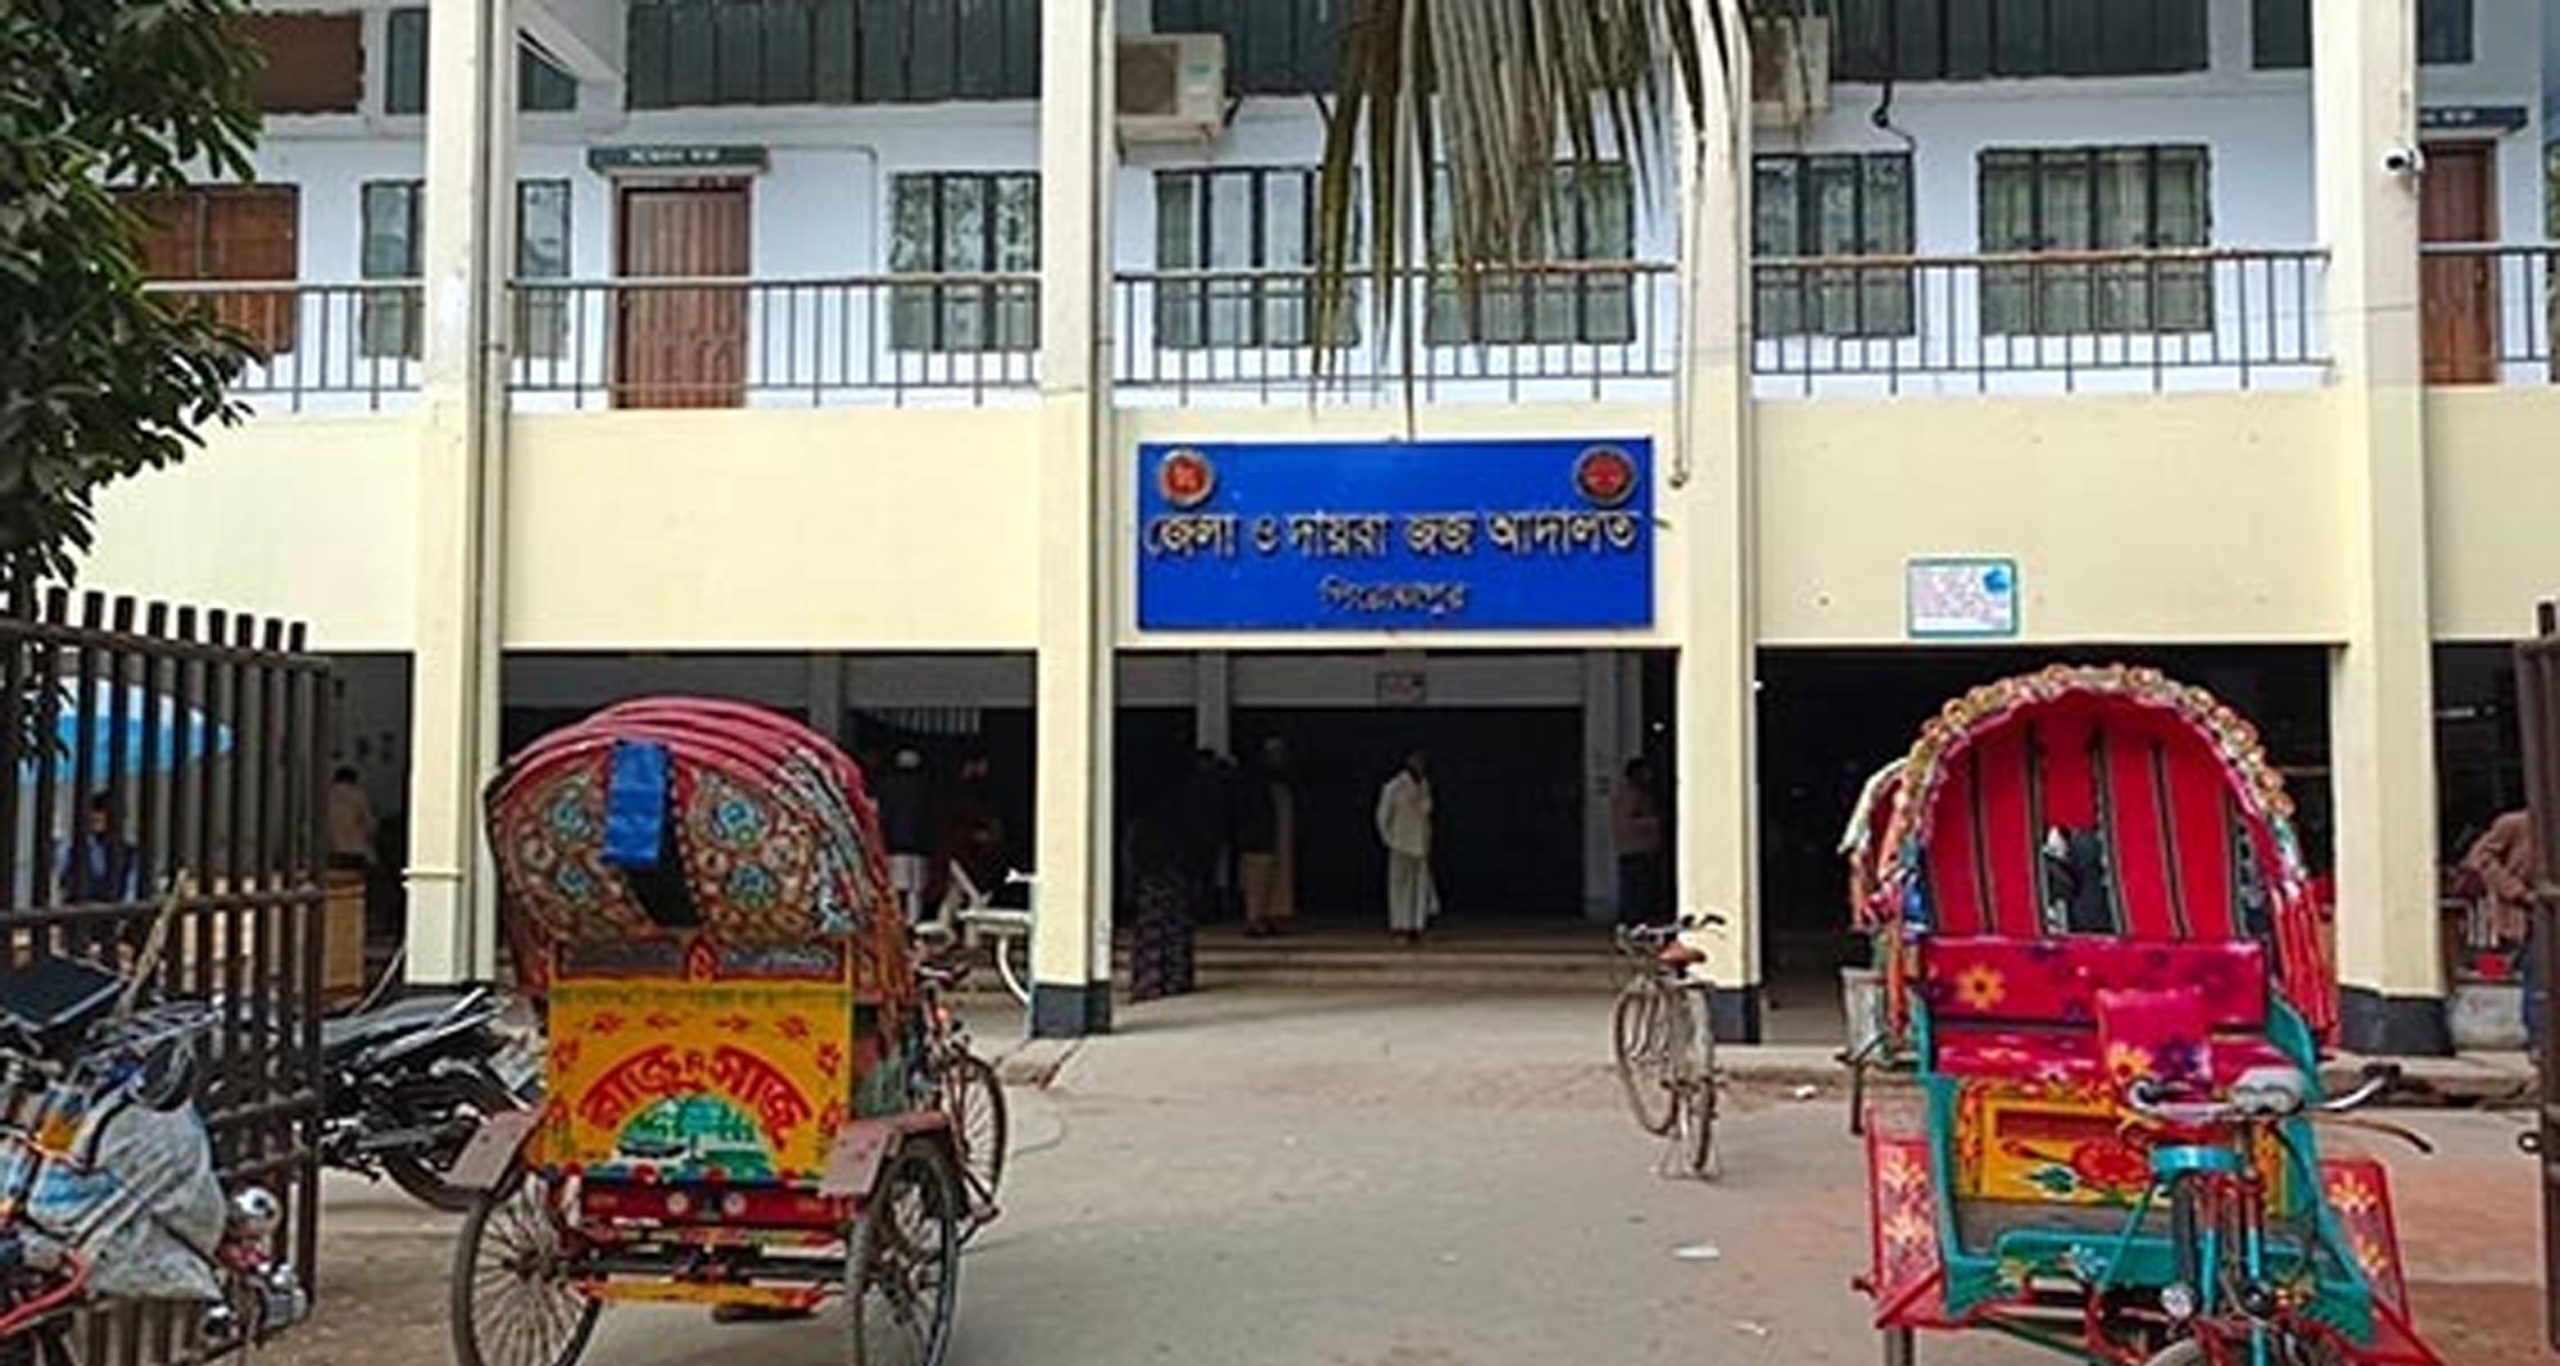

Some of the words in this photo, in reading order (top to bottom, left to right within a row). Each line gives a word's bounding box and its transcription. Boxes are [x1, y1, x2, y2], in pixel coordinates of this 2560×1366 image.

[1144, 511, 1235, 557] জেলা
[1253, 513, 1280, 552] ও
[1403, 512, 1477, 554] জজ
[1487, 507, 1641, 554] আদালত
